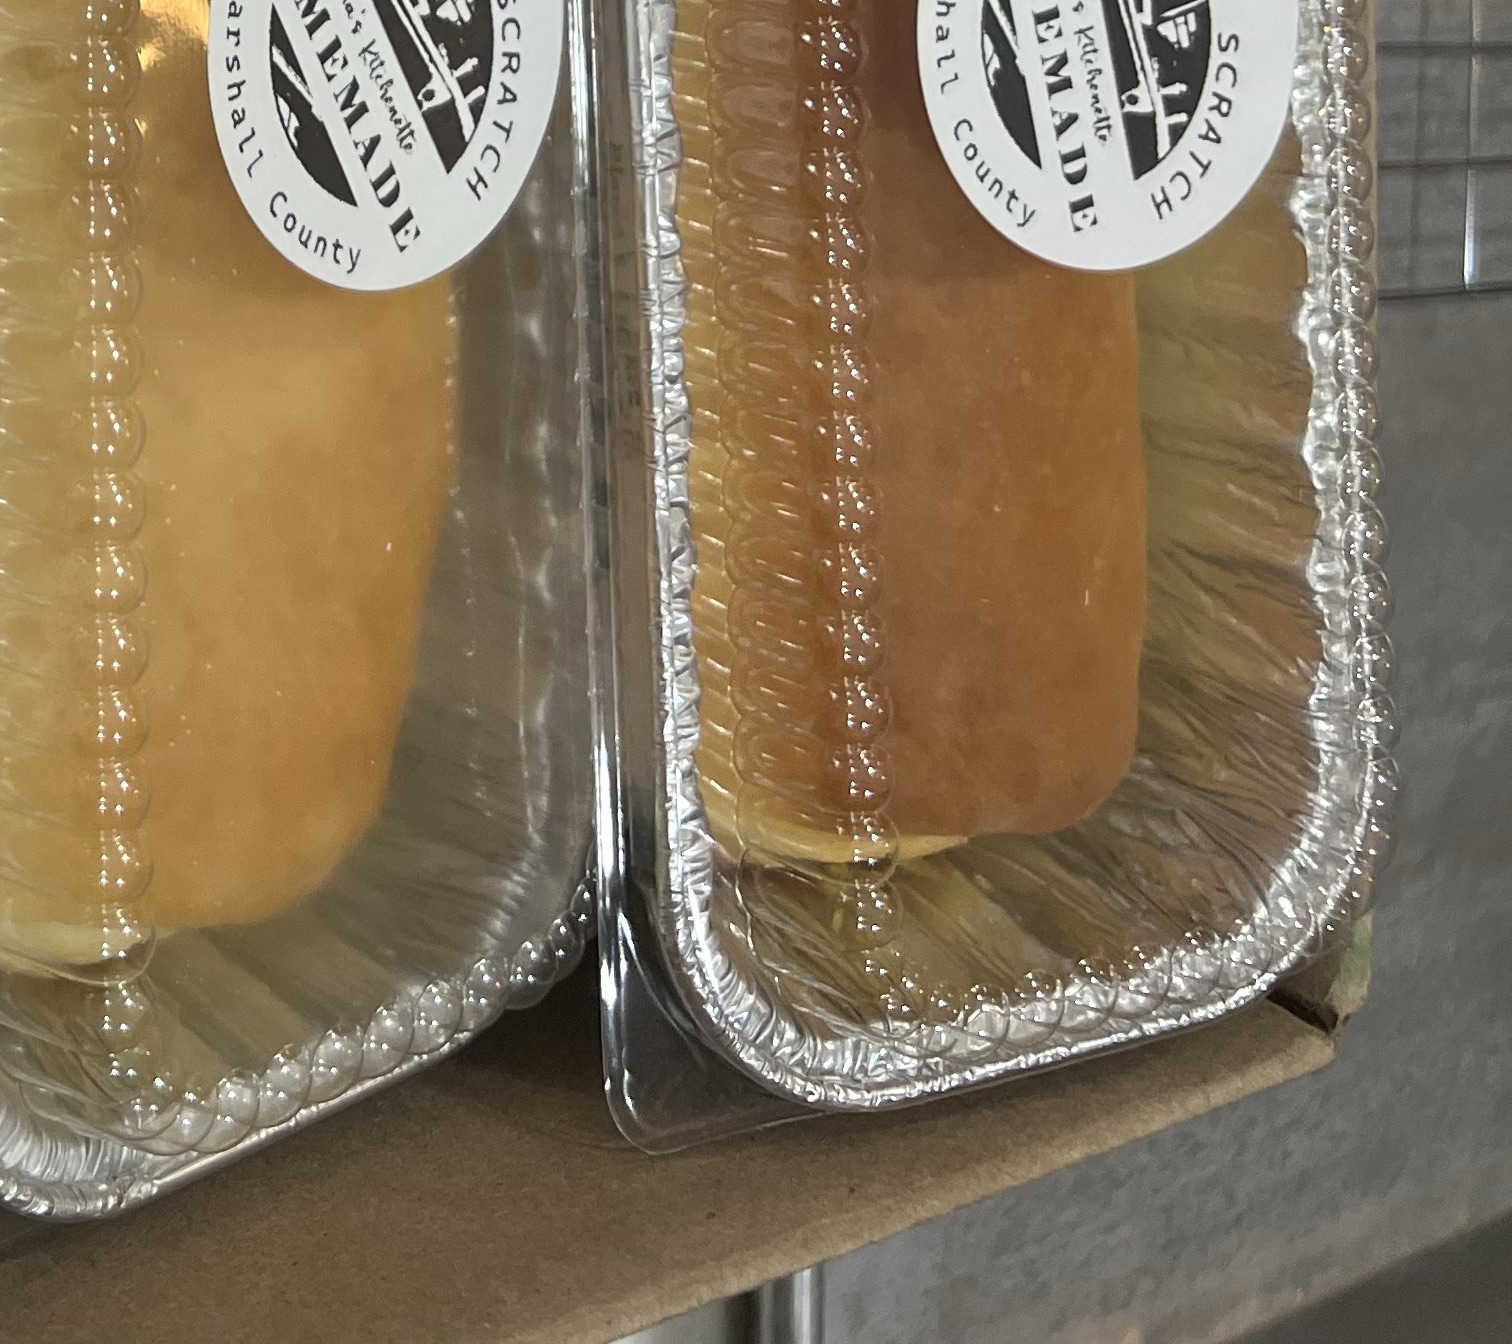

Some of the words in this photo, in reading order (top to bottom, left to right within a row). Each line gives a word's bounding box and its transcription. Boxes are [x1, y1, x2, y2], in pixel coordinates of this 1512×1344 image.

[953, 119, 1036, 229] County
[1150, 32, 1240, 220] SCRATCH
[269, 191, 361, 275] County
